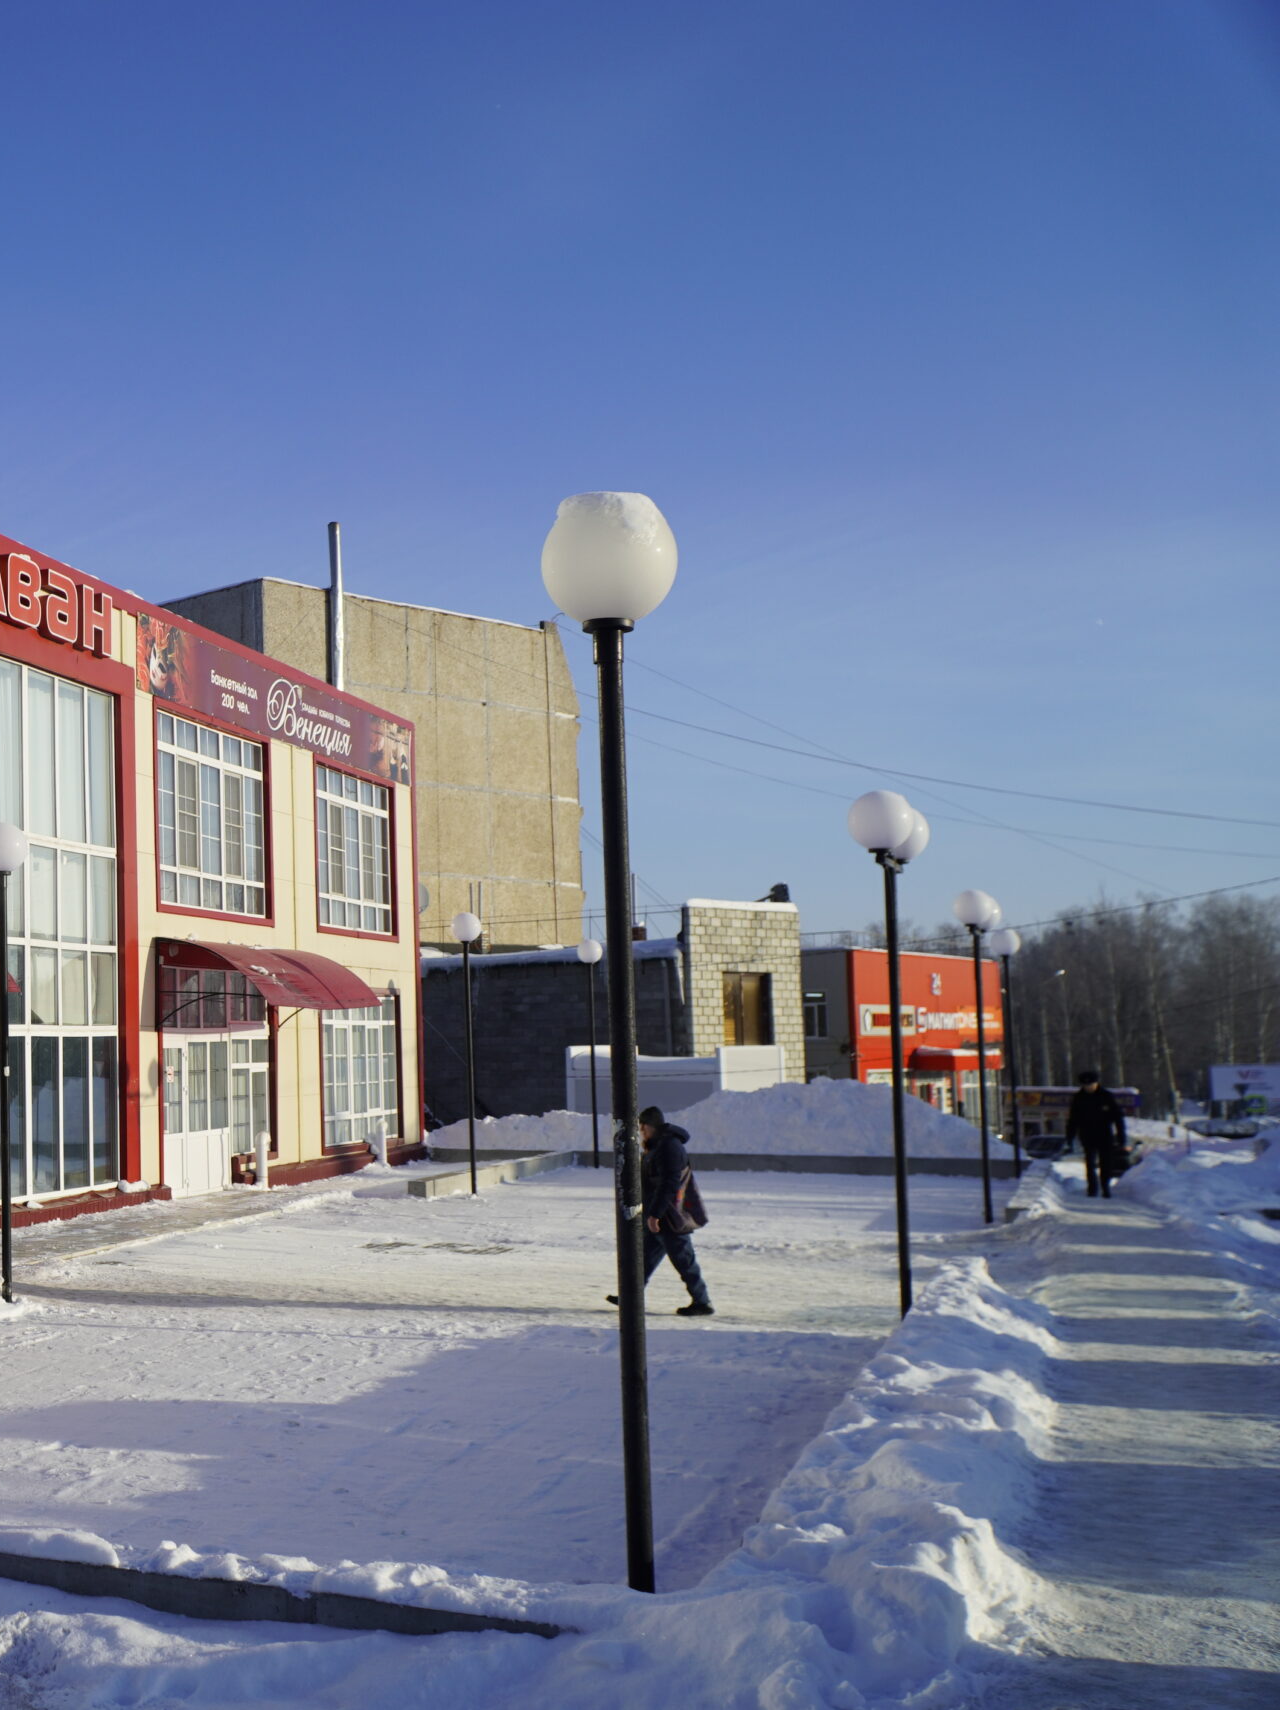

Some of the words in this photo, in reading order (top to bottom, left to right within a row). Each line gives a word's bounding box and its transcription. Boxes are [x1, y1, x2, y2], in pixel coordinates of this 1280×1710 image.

[210, 669, 248, 696] Банкетный
[221, 692, 235, 710] 200
[236, 700, 251, 715] чел.
[267, 678, 353, 757] Венеция
